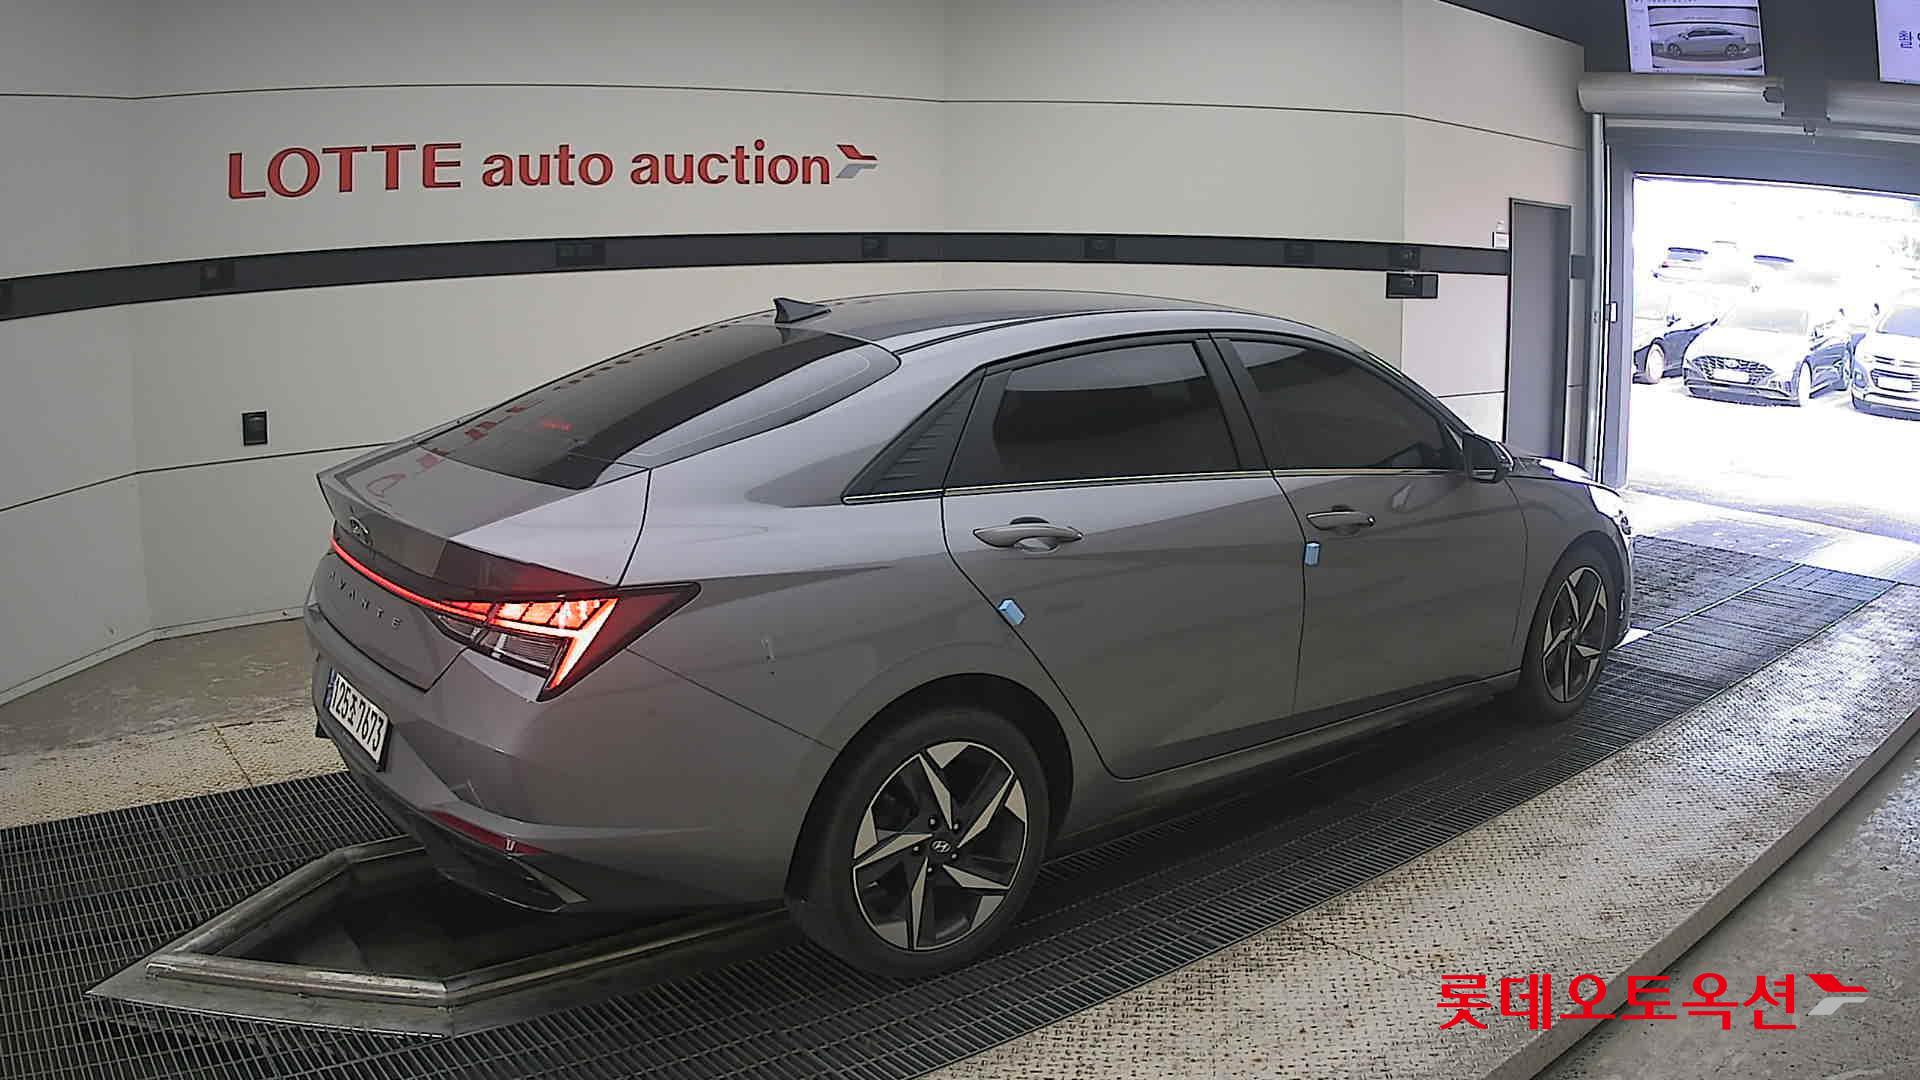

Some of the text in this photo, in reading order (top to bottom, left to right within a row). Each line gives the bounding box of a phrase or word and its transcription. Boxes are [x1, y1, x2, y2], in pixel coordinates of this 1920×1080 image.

[228, 139, 831, 199] LOTTE auto auction
[328, 571, 401, 629] AVANTE
